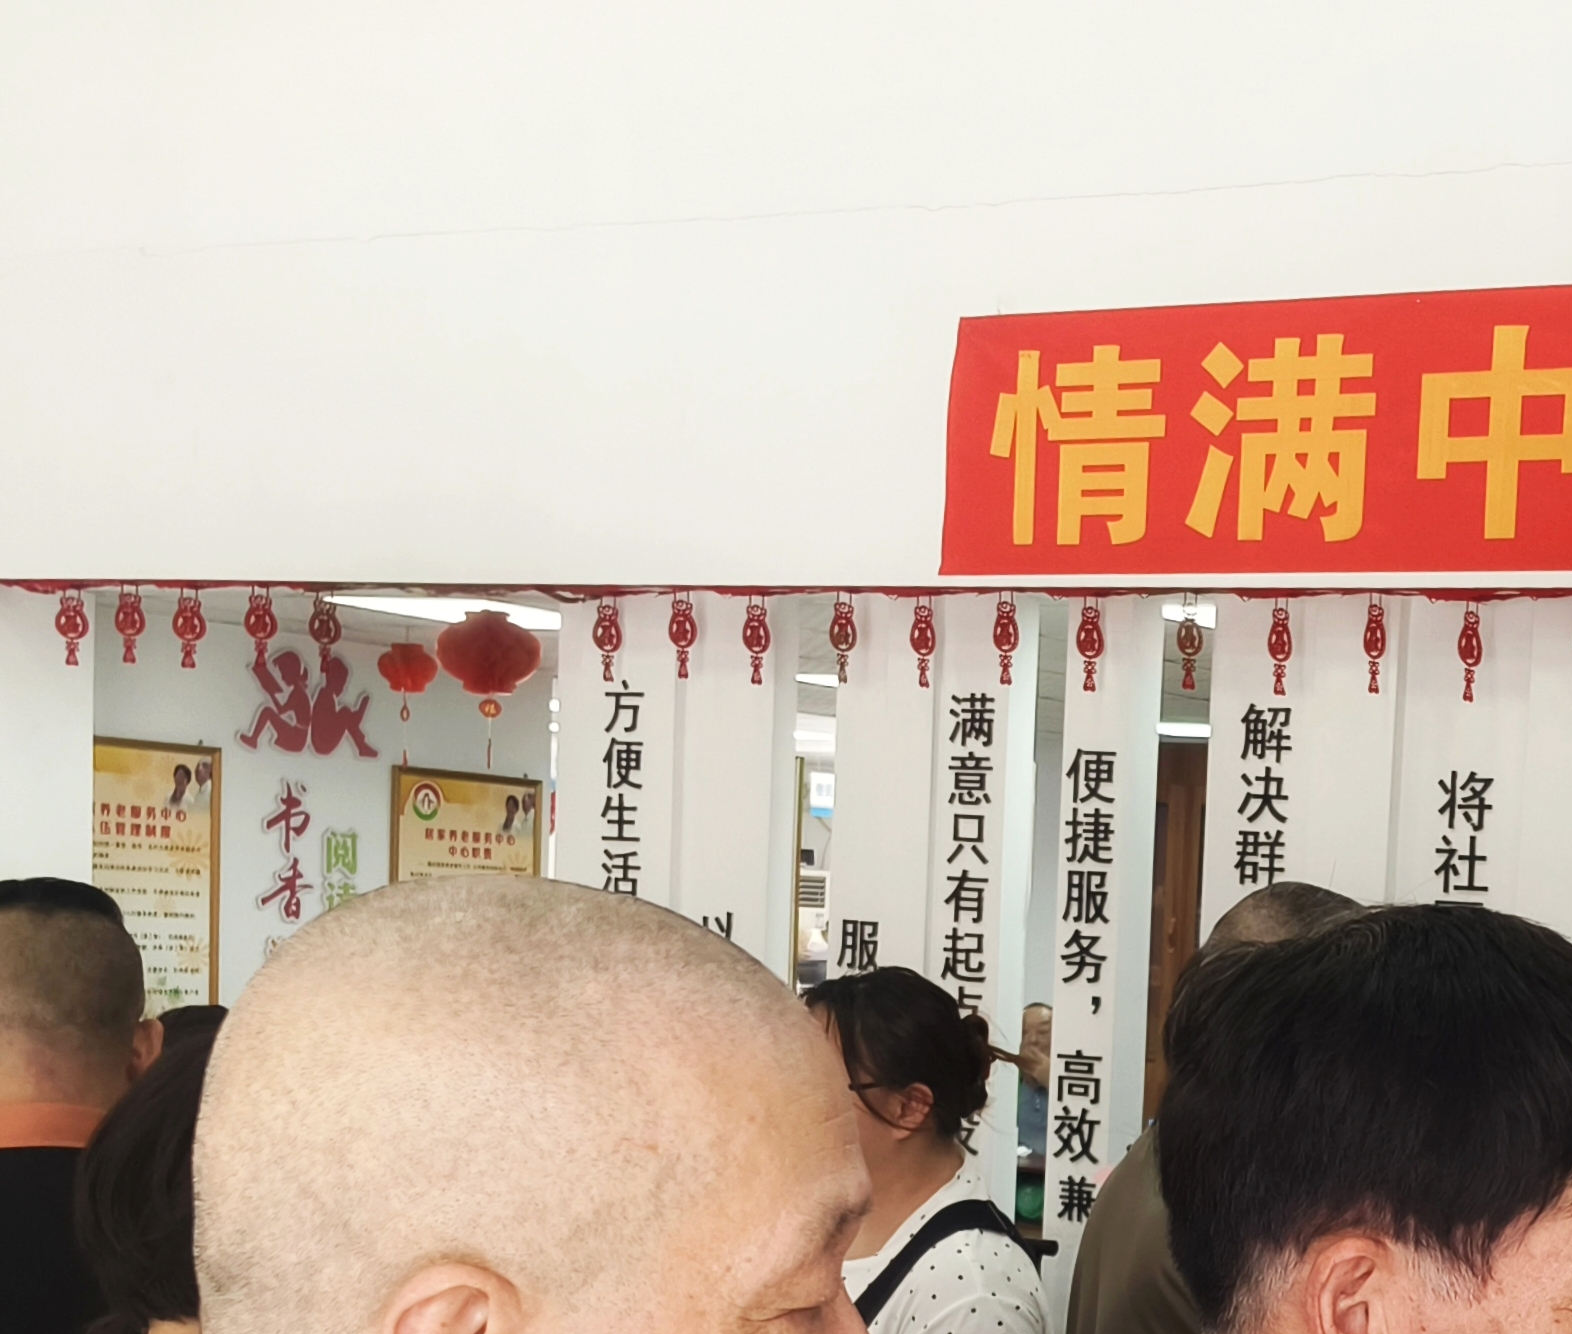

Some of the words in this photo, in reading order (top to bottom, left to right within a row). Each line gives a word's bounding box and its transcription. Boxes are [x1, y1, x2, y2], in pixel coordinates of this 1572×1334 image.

[94, 802, 187, 822] 养老服务中心
[260, 781, 314, 952] 书香
[600, 680, 645, 897] 方便生活
[1234, 703, 1293, 886] 解决群
[1434, 771, 1494, 907] 将社
[838, 918, 879, 971] 服
[940, 693, 996, 1156] 满意只有起
[1053, 748, 1117, 1222] 便捷服务，高效兼
